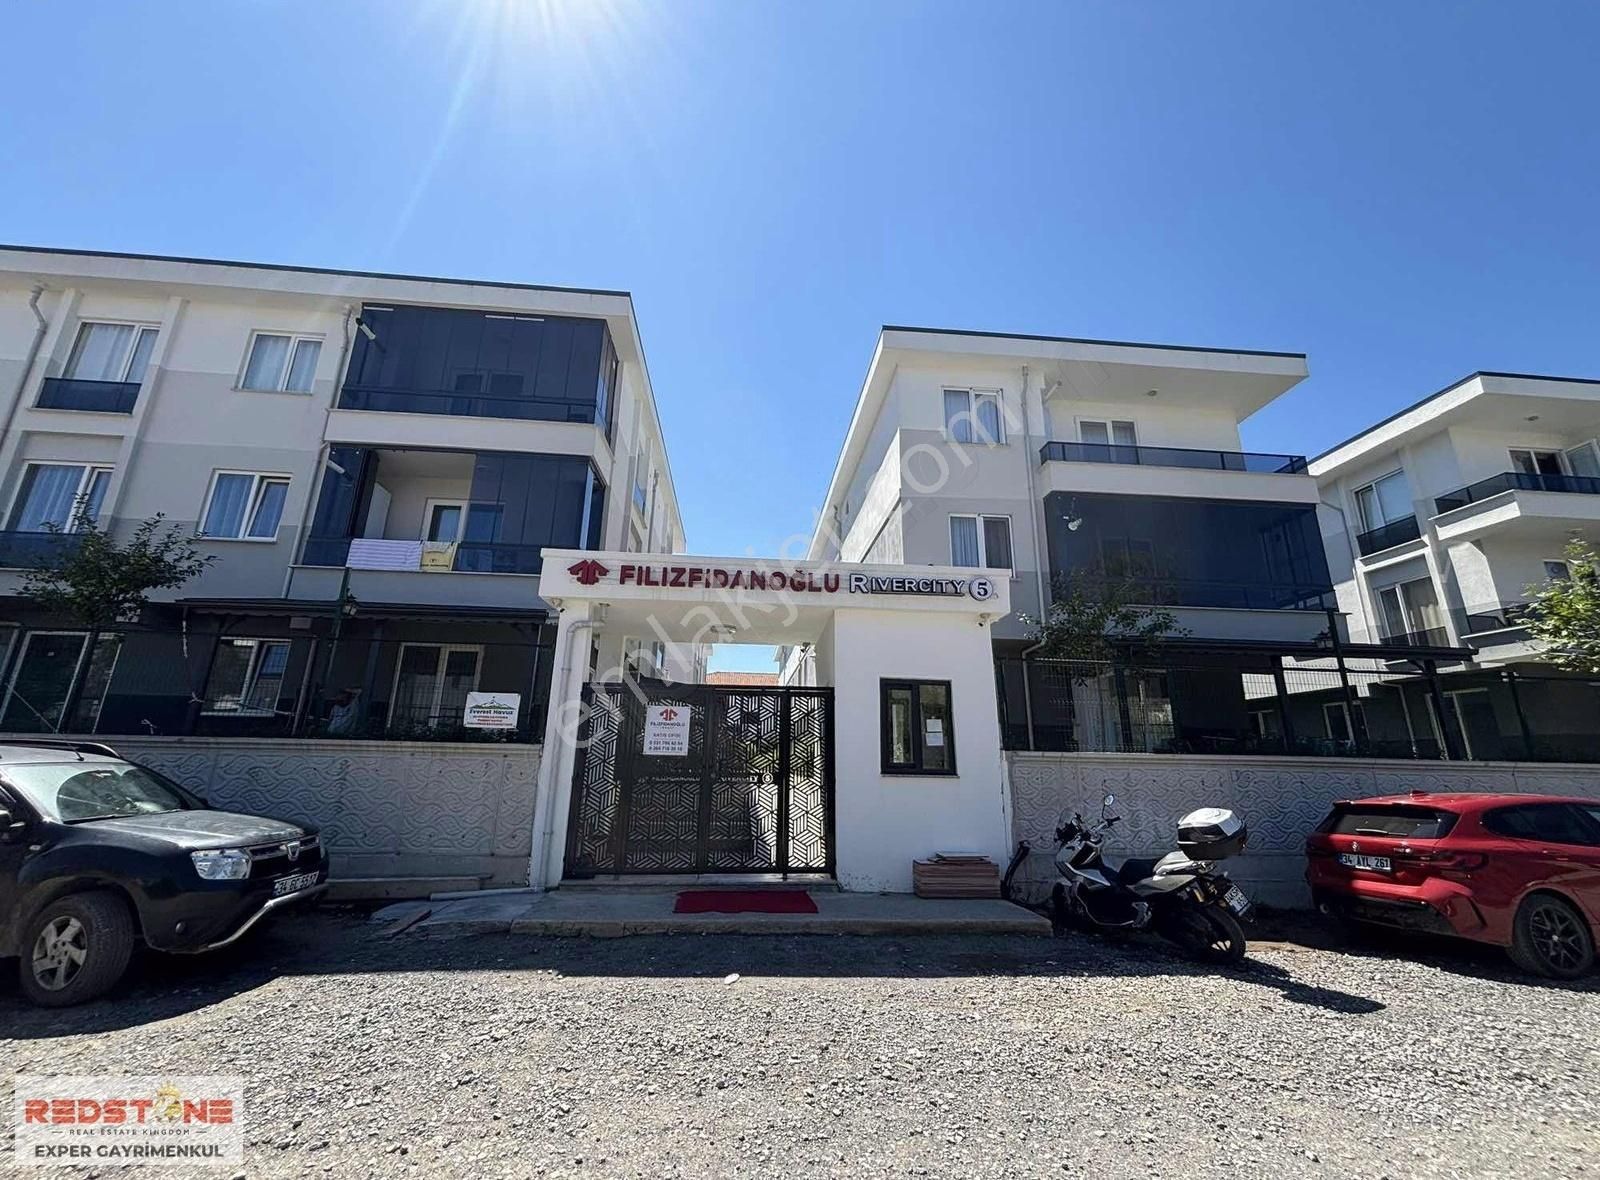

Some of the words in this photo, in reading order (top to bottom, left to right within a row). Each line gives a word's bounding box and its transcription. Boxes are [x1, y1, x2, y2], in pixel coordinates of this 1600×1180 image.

[849, 573, 965, 596] RIVERCITY
[1343, 855, 1352, 864] 34
[1357, 856, 1371, 867] AYL
